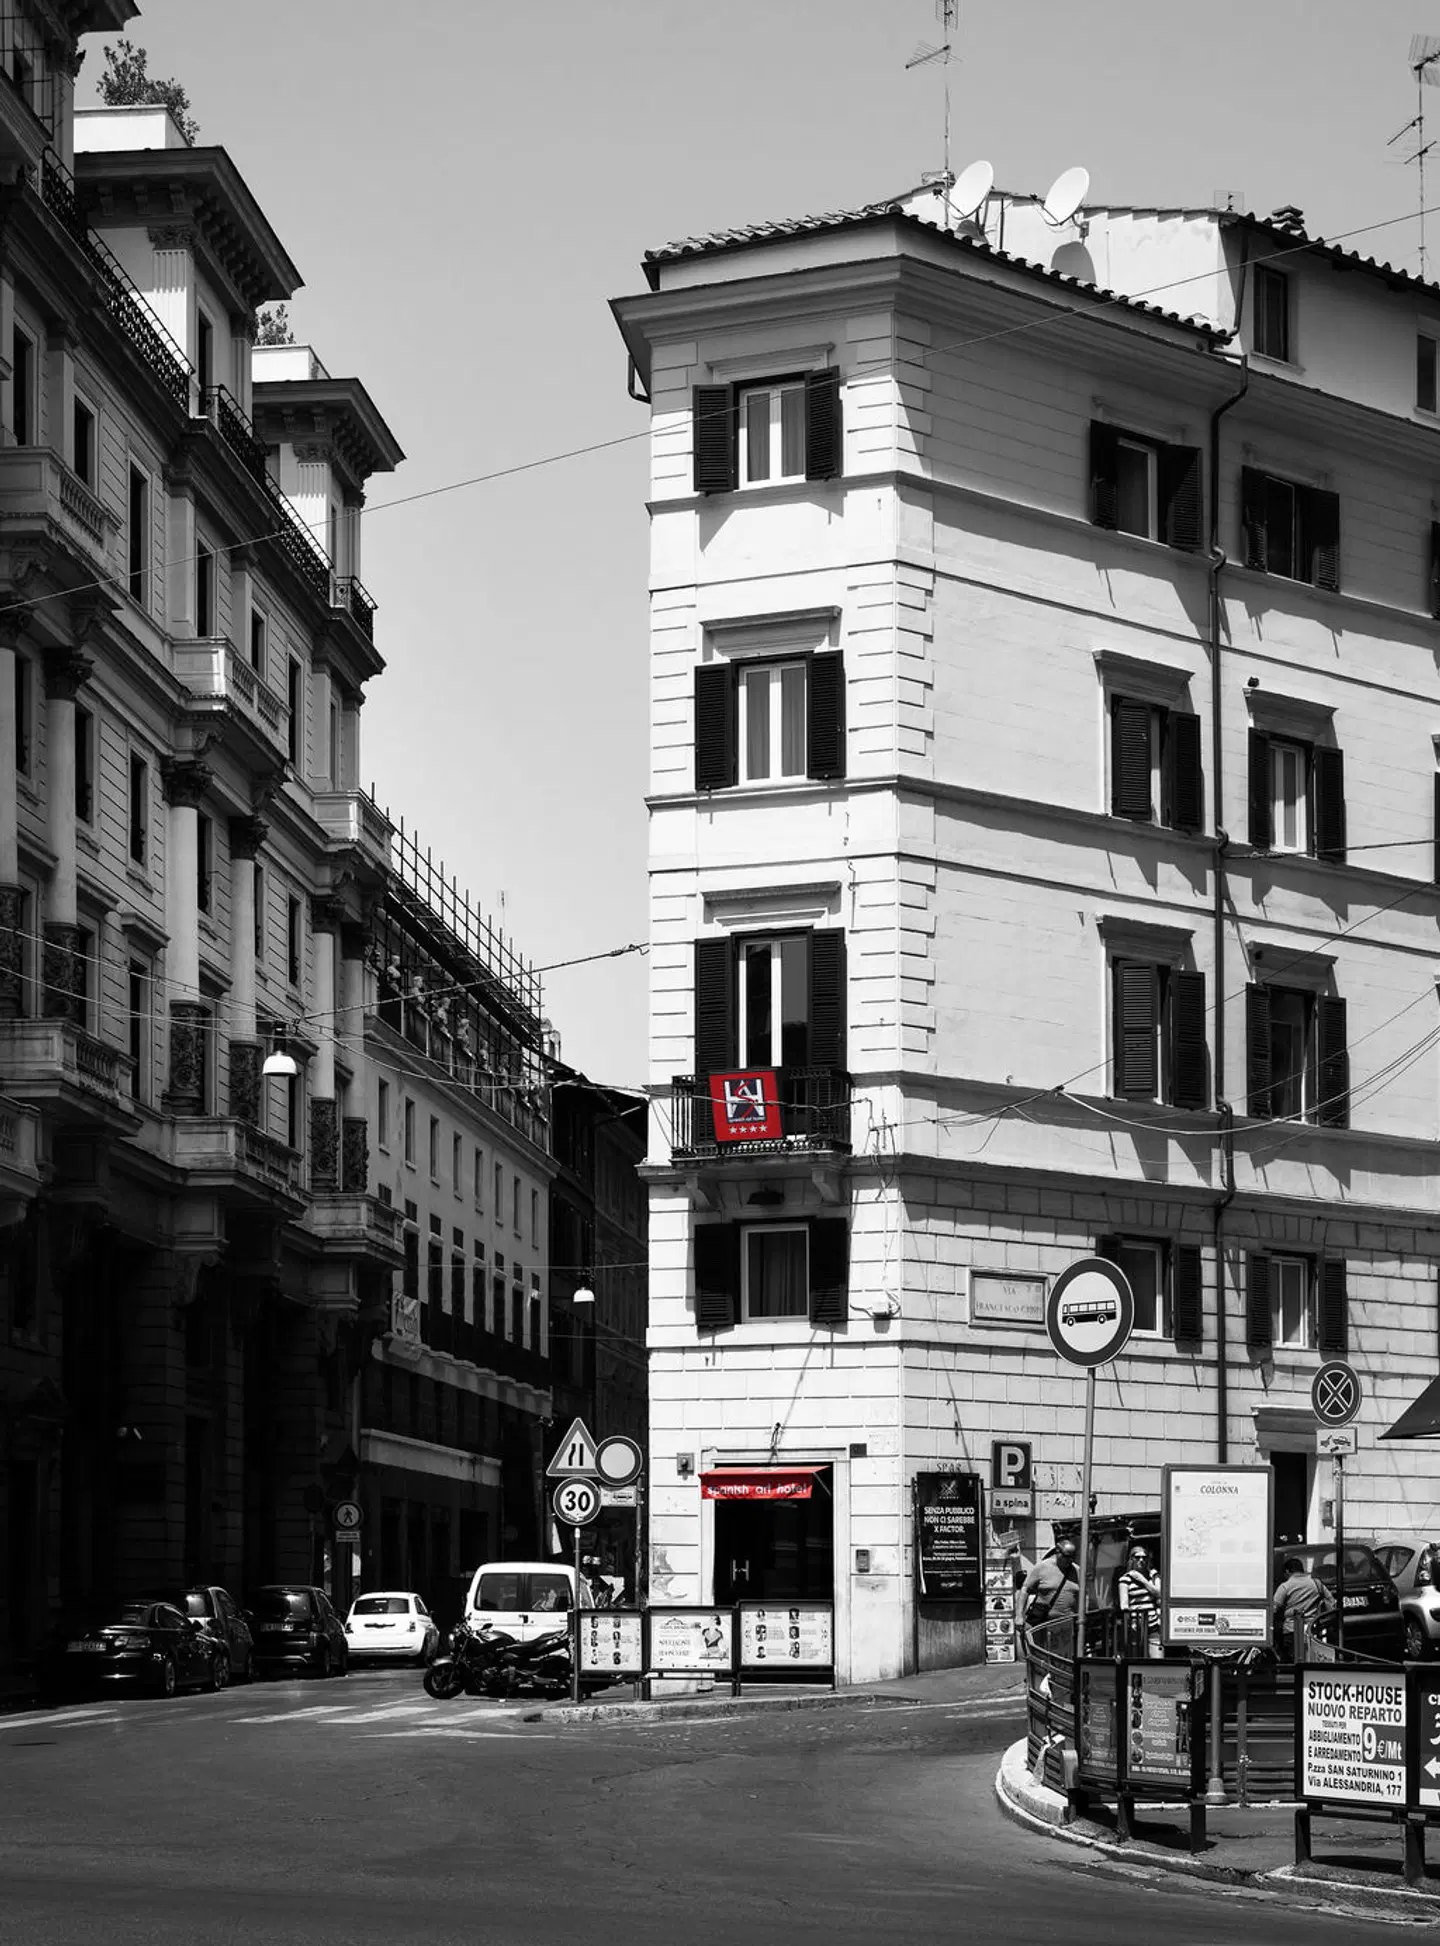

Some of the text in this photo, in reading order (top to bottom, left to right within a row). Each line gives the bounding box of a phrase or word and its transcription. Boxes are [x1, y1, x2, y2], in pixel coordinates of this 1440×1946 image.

[1001, 1446, 1025, 1486] P
[707, 1482, 807, 1496] spanish art hotel
[1200, 1485, 1239, 1494] COLONNA
[565, 1490, 591, 1512] 30
[995, 1498, 1029, 1509] a spina
[924, 1506, 975, 1515] SENZA PUBBLICO
[924, 1516, 975, 1524] NON CI SAREBBE
[934, 1525, 939, 1533] X
[1308, 1681, 1403, 1706] STOCK-HOUSE
[1308, 1702, 1402, 1723] NUOVO REPARTO
[1309, 1729, 1361, 1746] ABBIGLIAMENTO
[1363, 1726, 1377, 1760] 9
[1308, 1746, 1361, 1763] E ARREDAMENTO
[1308, 1762, 1402, 1782] P.zza SAN SATURNINO 1
[1308, 1776, 1321, 1787] Via
[1386, 1784, 1402, 1796] 177
